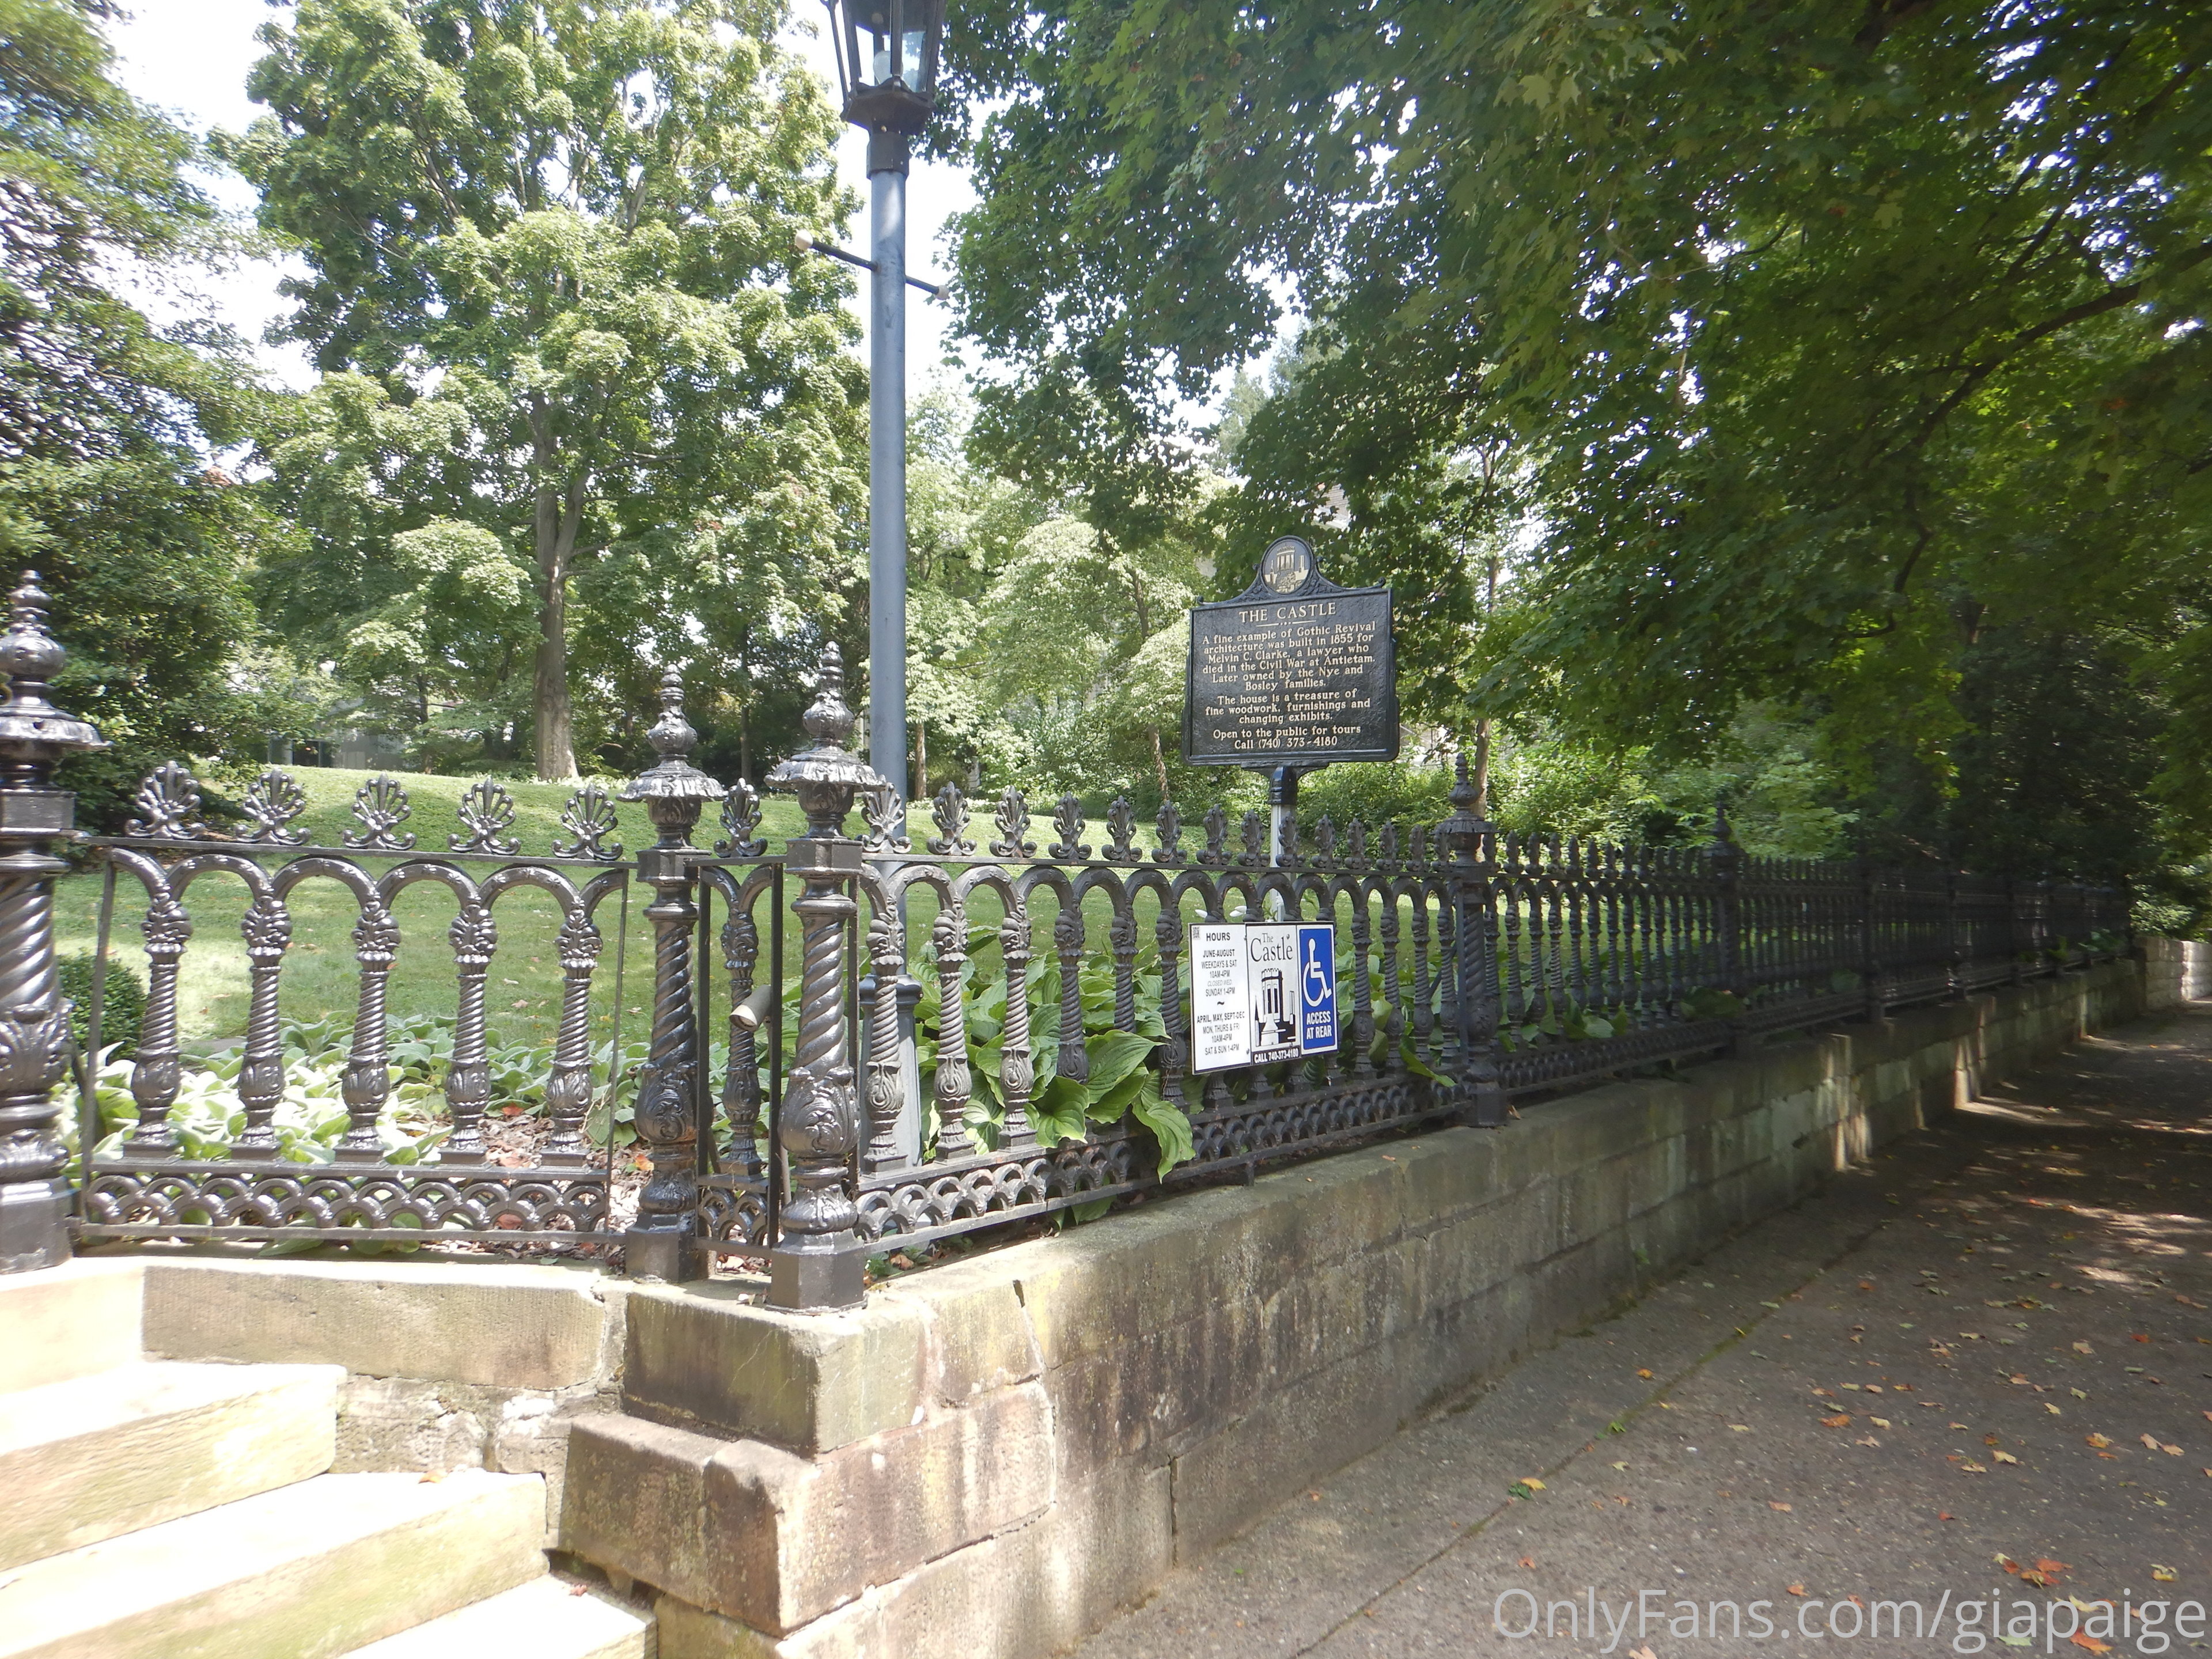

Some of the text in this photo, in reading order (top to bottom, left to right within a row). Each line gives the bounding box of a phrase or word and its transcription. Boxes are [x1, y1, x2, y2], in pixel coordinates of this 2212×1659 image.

[1239, 602, 1337, 623] THE CASTLE
[1202, 621, 1376, 645] A fine example of Gothic Revival
[1204, 643, 1264, 654] architecture
[1289, 637, 1313, 647] built
[1317, 637, 1326, 645] in
[1331, 633, 1353, 644] 1855
[1357, 632, 1374, 642] for
[1209, 654, 1239, 664] Melvin
[1243, 652, 1252, 661] C.
[1255, 649, 1290, 660] Clarke,
[1308, 646, 1343, 656] lawyer
[1348, 643, 1369, 653] who
[1202, 654, 1375, 674] died in the Civil War at Antietam.
[1213, 664, 1363, 683] Later owned by the Nye and
[1245, 679, 1326, 691] Bosley families.
[1217, 696, 1236, 705] The
[1240, 695, 1268, 704] house
[1272, 694, 1279, 702] is
[1294, 691, 1340, 700] treasure
[1344, 688, 1358, 698] of
[1205, 698, 1370, 715] fine woodwork, furnishings and
[1239, 711, 1333, 725] changing exhibits.
[1213, 725, 1361, 741] Open to the public for tours
[1234, 736, 1338, 749] Call (740) 373-4180
[1206, 932, 1230, 941] HOURS
[1262, 933, 1274, 942] The
[1203, 949, 1235, 958] JUNE-AUGUST
[1251, 937, 1293, 962] Castle
[1202, 960, 1225, 969] WEEKDAYS
[1210, 969, 1230, 979] 10AM-4PM
[1206, 987, 1235, 997] SUNDAY 1-4PM
[1197, 1011, 1245, 1024] APRIL, MAY, SEPT-DEC
[1306, 1011, 1331, 1025] ACCESS
[1215, 1024, 1229, 1032] THURS
[1306, 1025, 1332, 1040] AT REAR
[1214, 1046, 1217, 1054] &
[1218, 1046, 1227, 1054] SUN
[1254, 1048, 1299, 1063] CALL 740-373-4180
